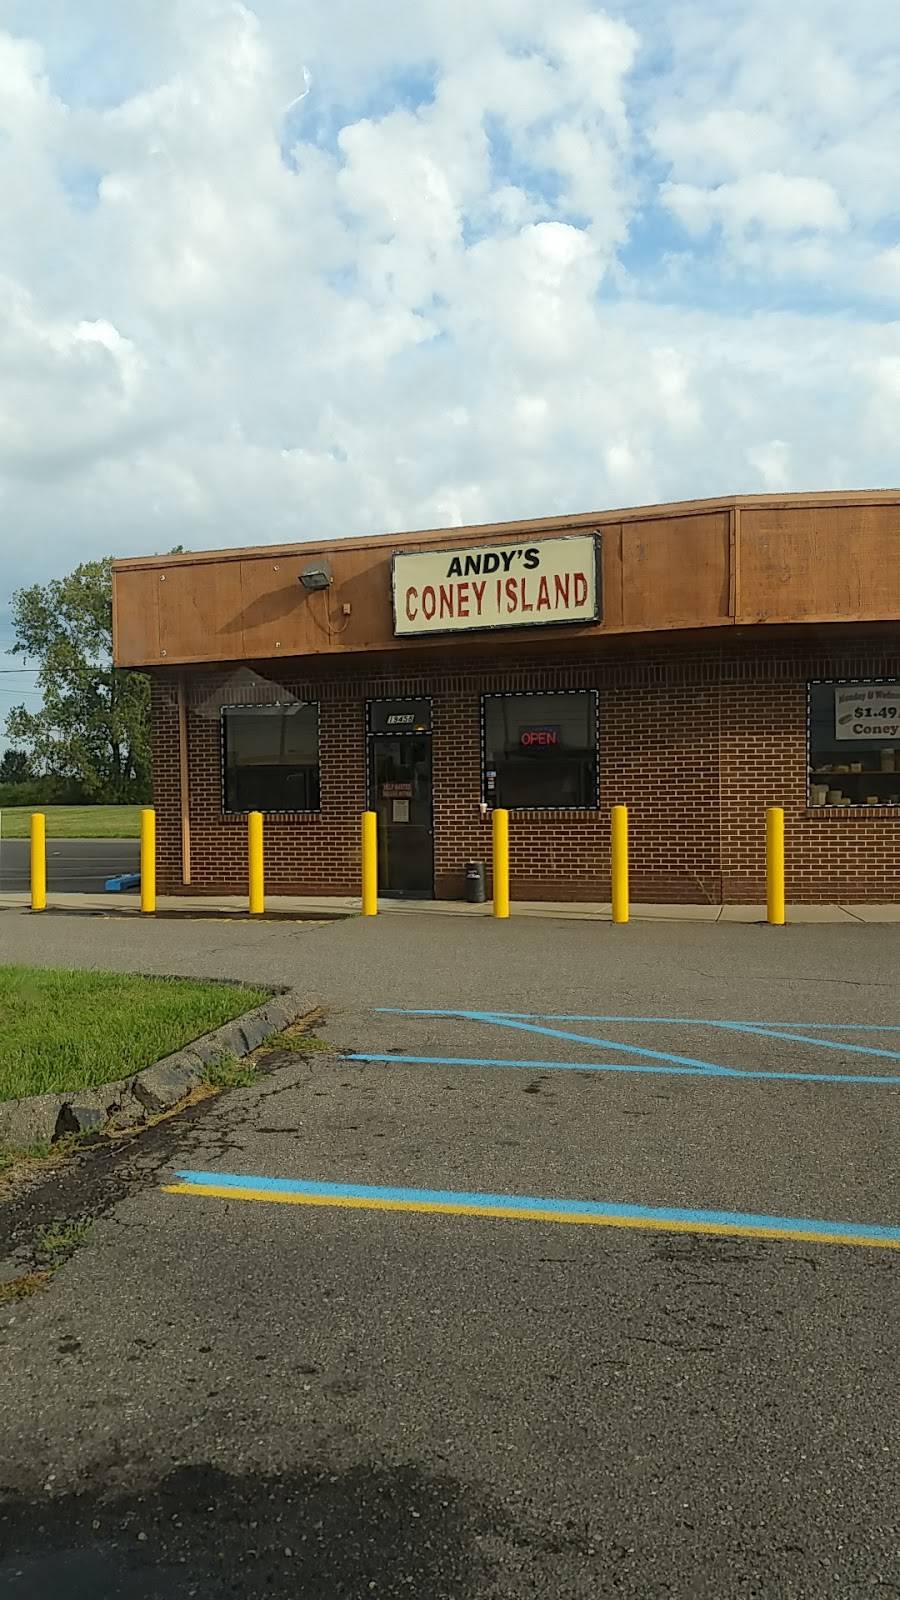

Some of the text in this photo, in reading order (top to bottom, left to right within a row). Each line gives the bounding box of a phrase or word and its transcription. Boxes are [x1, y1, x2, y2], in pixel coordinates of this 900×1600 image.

[447, 548, 540, 577] ANDY'S
[405, 572, 588, 621] CONEY ISLAND
[854, 706, 897, 718] $1.49
[852, 724, 899, 735] Coney
[521, 732, 556, 745] OPEN
